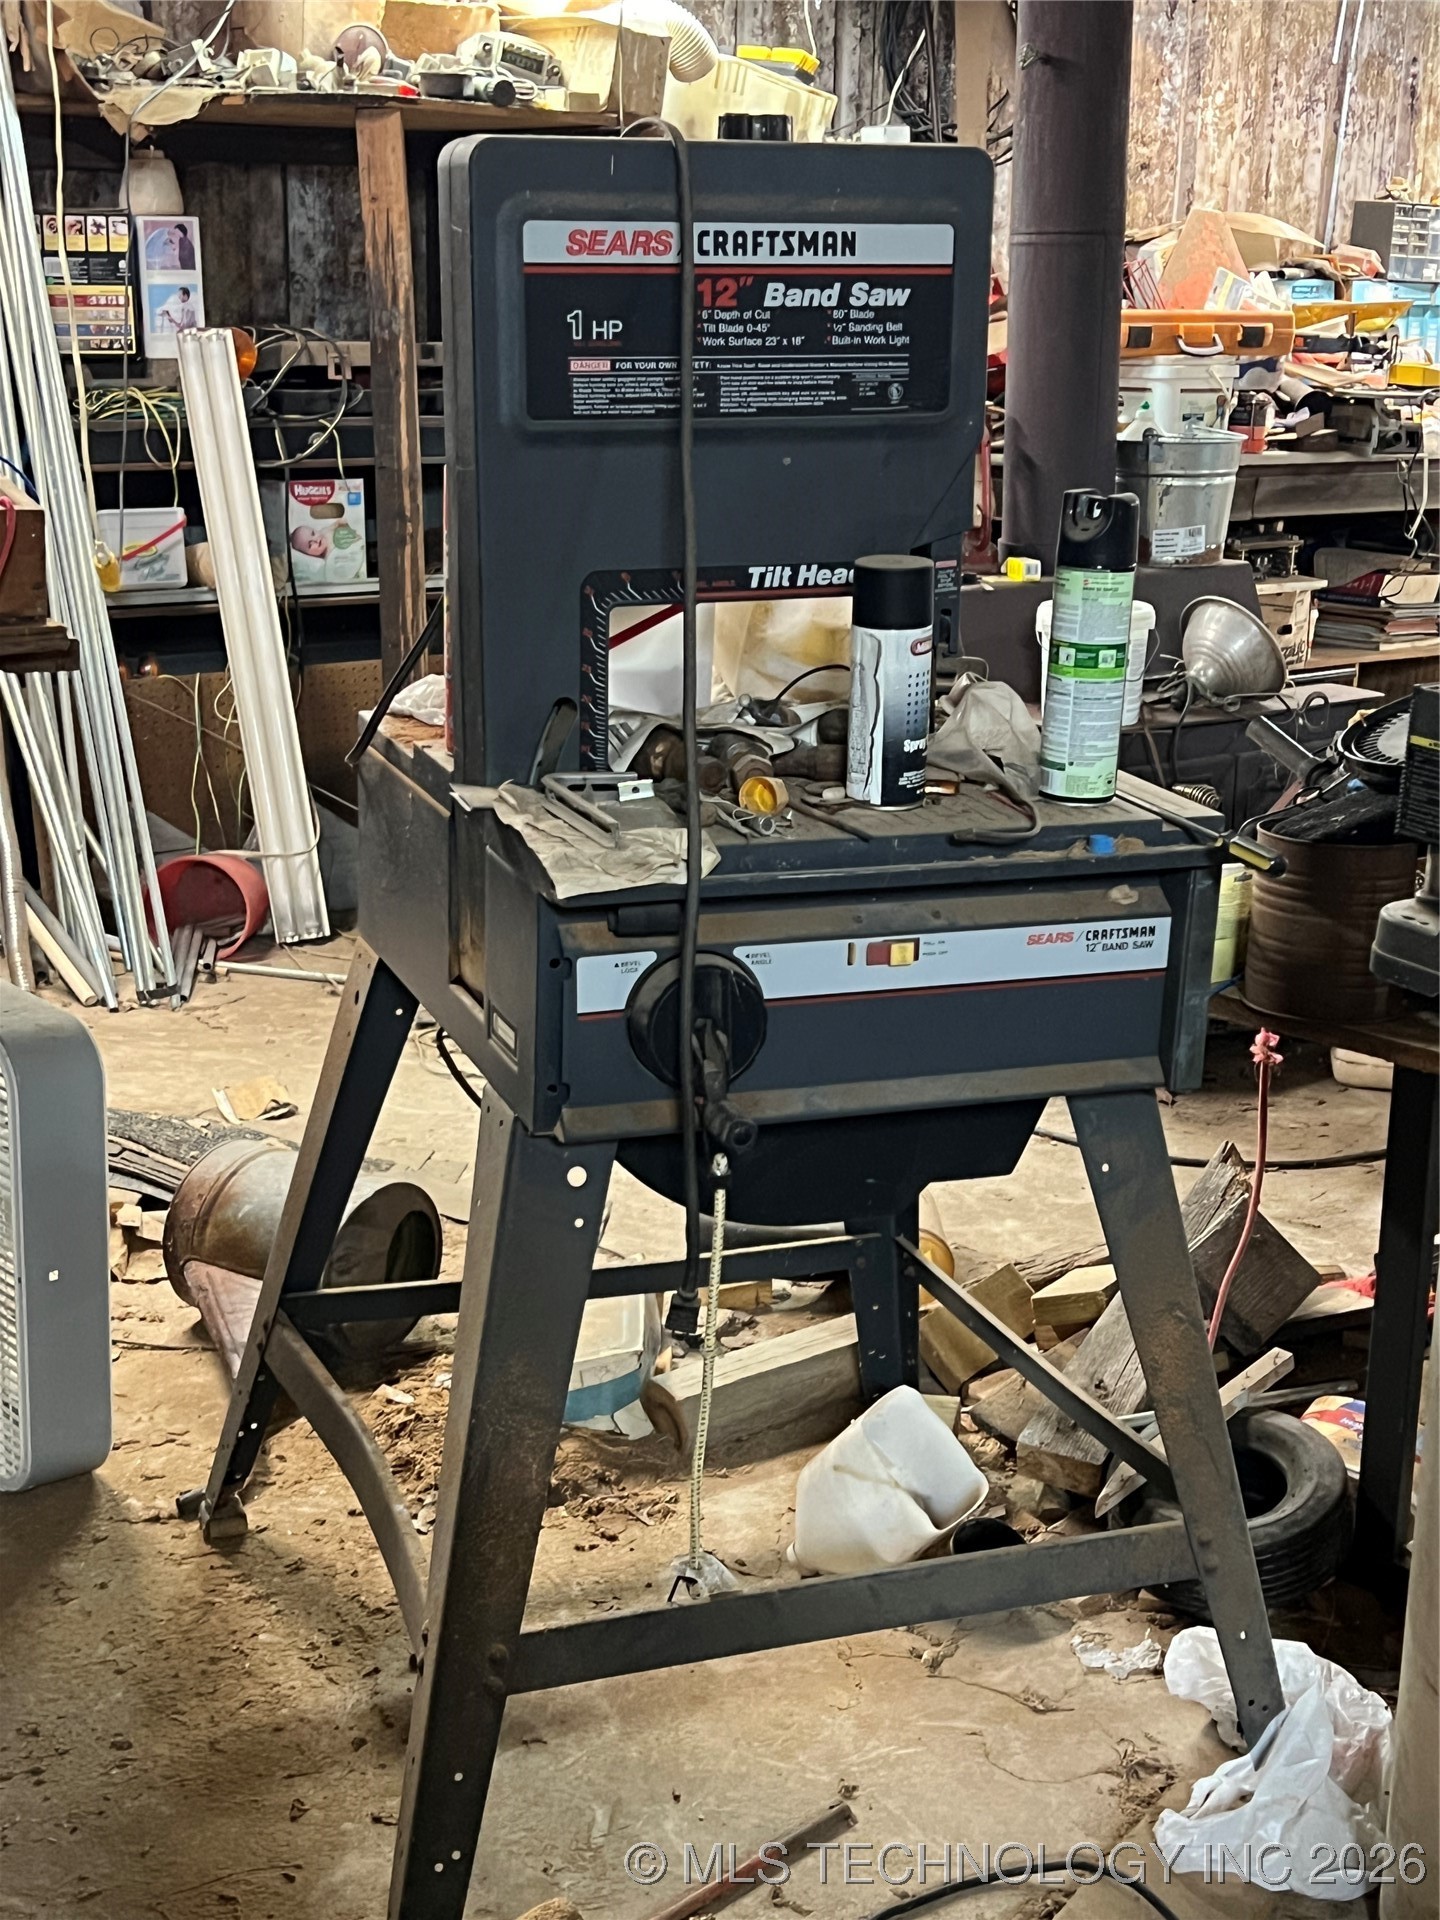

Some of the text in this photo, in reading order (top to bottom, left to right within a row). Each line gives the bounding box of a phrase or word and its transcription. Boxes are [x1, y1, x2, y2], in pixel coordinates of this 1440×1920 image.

[566, 229, 857, 257] SEARS CRAFTSMAN
[696, 276, 912, 307] 12" Band Saw
[714, 309, 740, 320] Depth
[743, 309, 752, 319] of
[755, 309, 771, 319] Cut
[850, 309, 875, 319] Blade
[567, 310, 623, 340] 1 HP
[703, 323, 716, 333] Tilt
[719, 323, 743, 333] Blade
[849, 322, 884, 333] Sanding
[886, 322, 903, 332] Belt
[702, 336, 726, 346] Work
[728, 336, 762, 346] Surface
[832, 335, 910, 347] Built-in Work Light
[615, 361, 632, 369] FOR
[634, 361, 657, 369] YOUR
[658, 361, 677, 369] OWN
[748, 565, 792, 588] Tilt
[1026, 931, 1075, 946] SEARS
[1085, 925, 1156, 941] CRAFTSMAN
[1101, 941, 1129, 952] BAND
[1132, 940, 1154, 950] SAW
